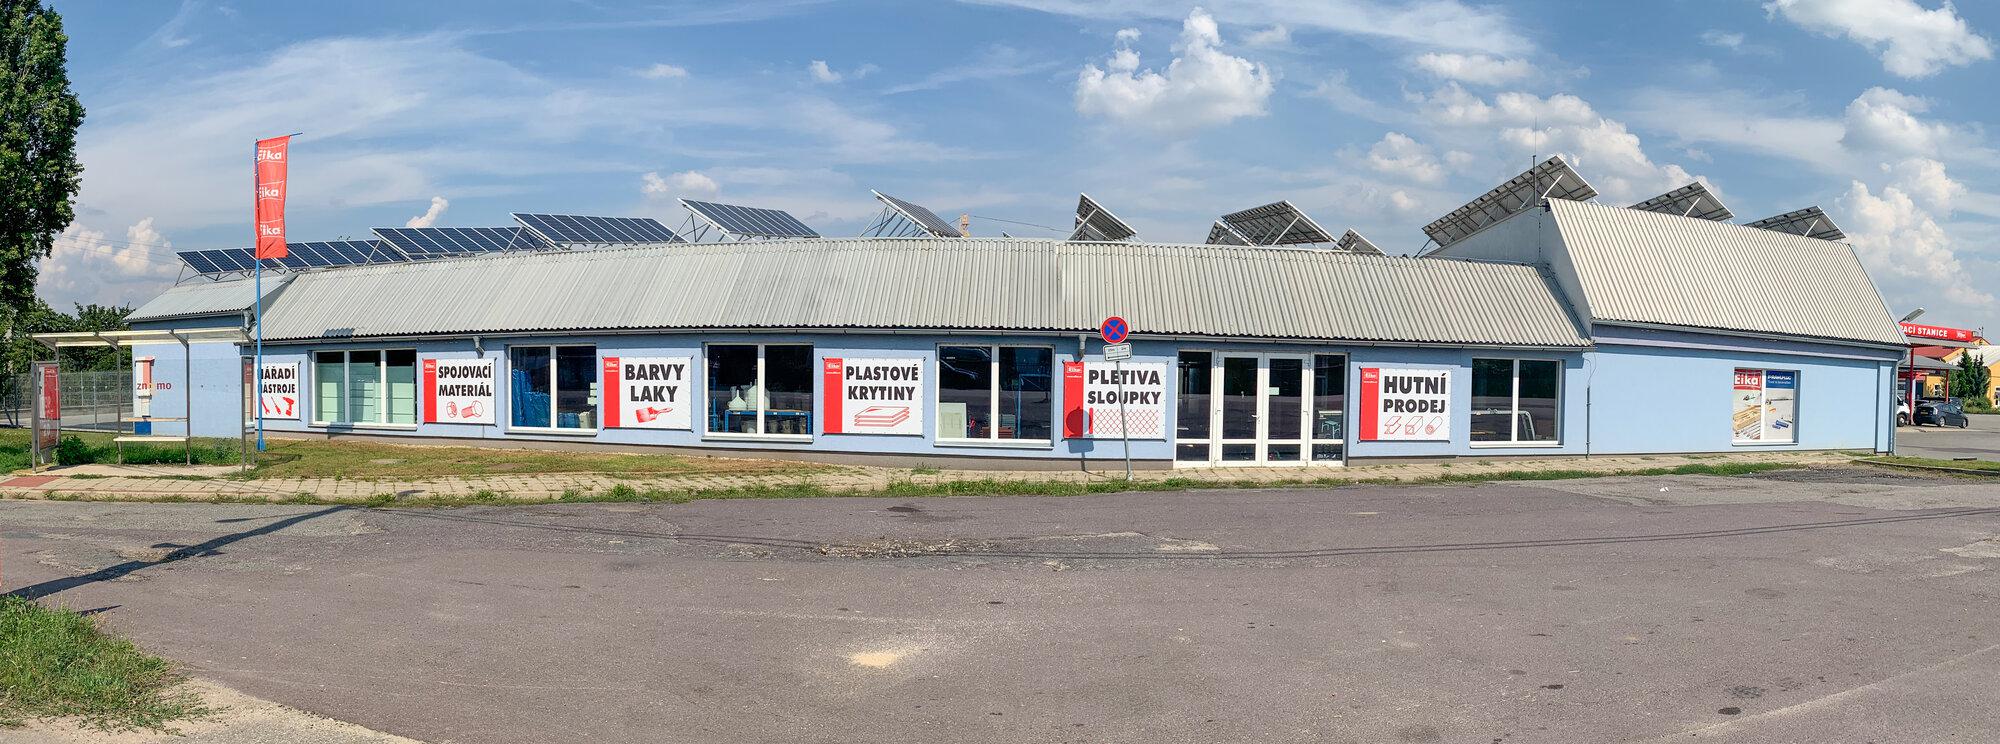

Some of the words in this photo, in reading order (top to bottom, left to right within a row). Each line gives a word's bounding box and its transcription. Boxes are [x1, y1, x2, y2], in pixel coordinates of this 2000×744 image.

[1918, 327, 1948, 337] STANICE
[438, 362, 492, 379] SPOJOVACÍ
[625, 363, 685, 381] BARVY
[846, 363, 919, 381] PLASTOVÉ
[1088, 369, 1161, 385] PLETIVA
[1383, 373, 1447, 394] HUTNÍ
[1734, 374, 1759, 385] Eika
[260, 382, 296, 394] ÁSTROJE
[438, 382, 492, 397] MATERIÁL
[630, 385, 678, 402] LAKY
[848, 386, 916, 400] KRYTINY
[1087, 390, 1162, 405] SLOUPKY
[1383, 399, 1446, 414] PRODEJ
